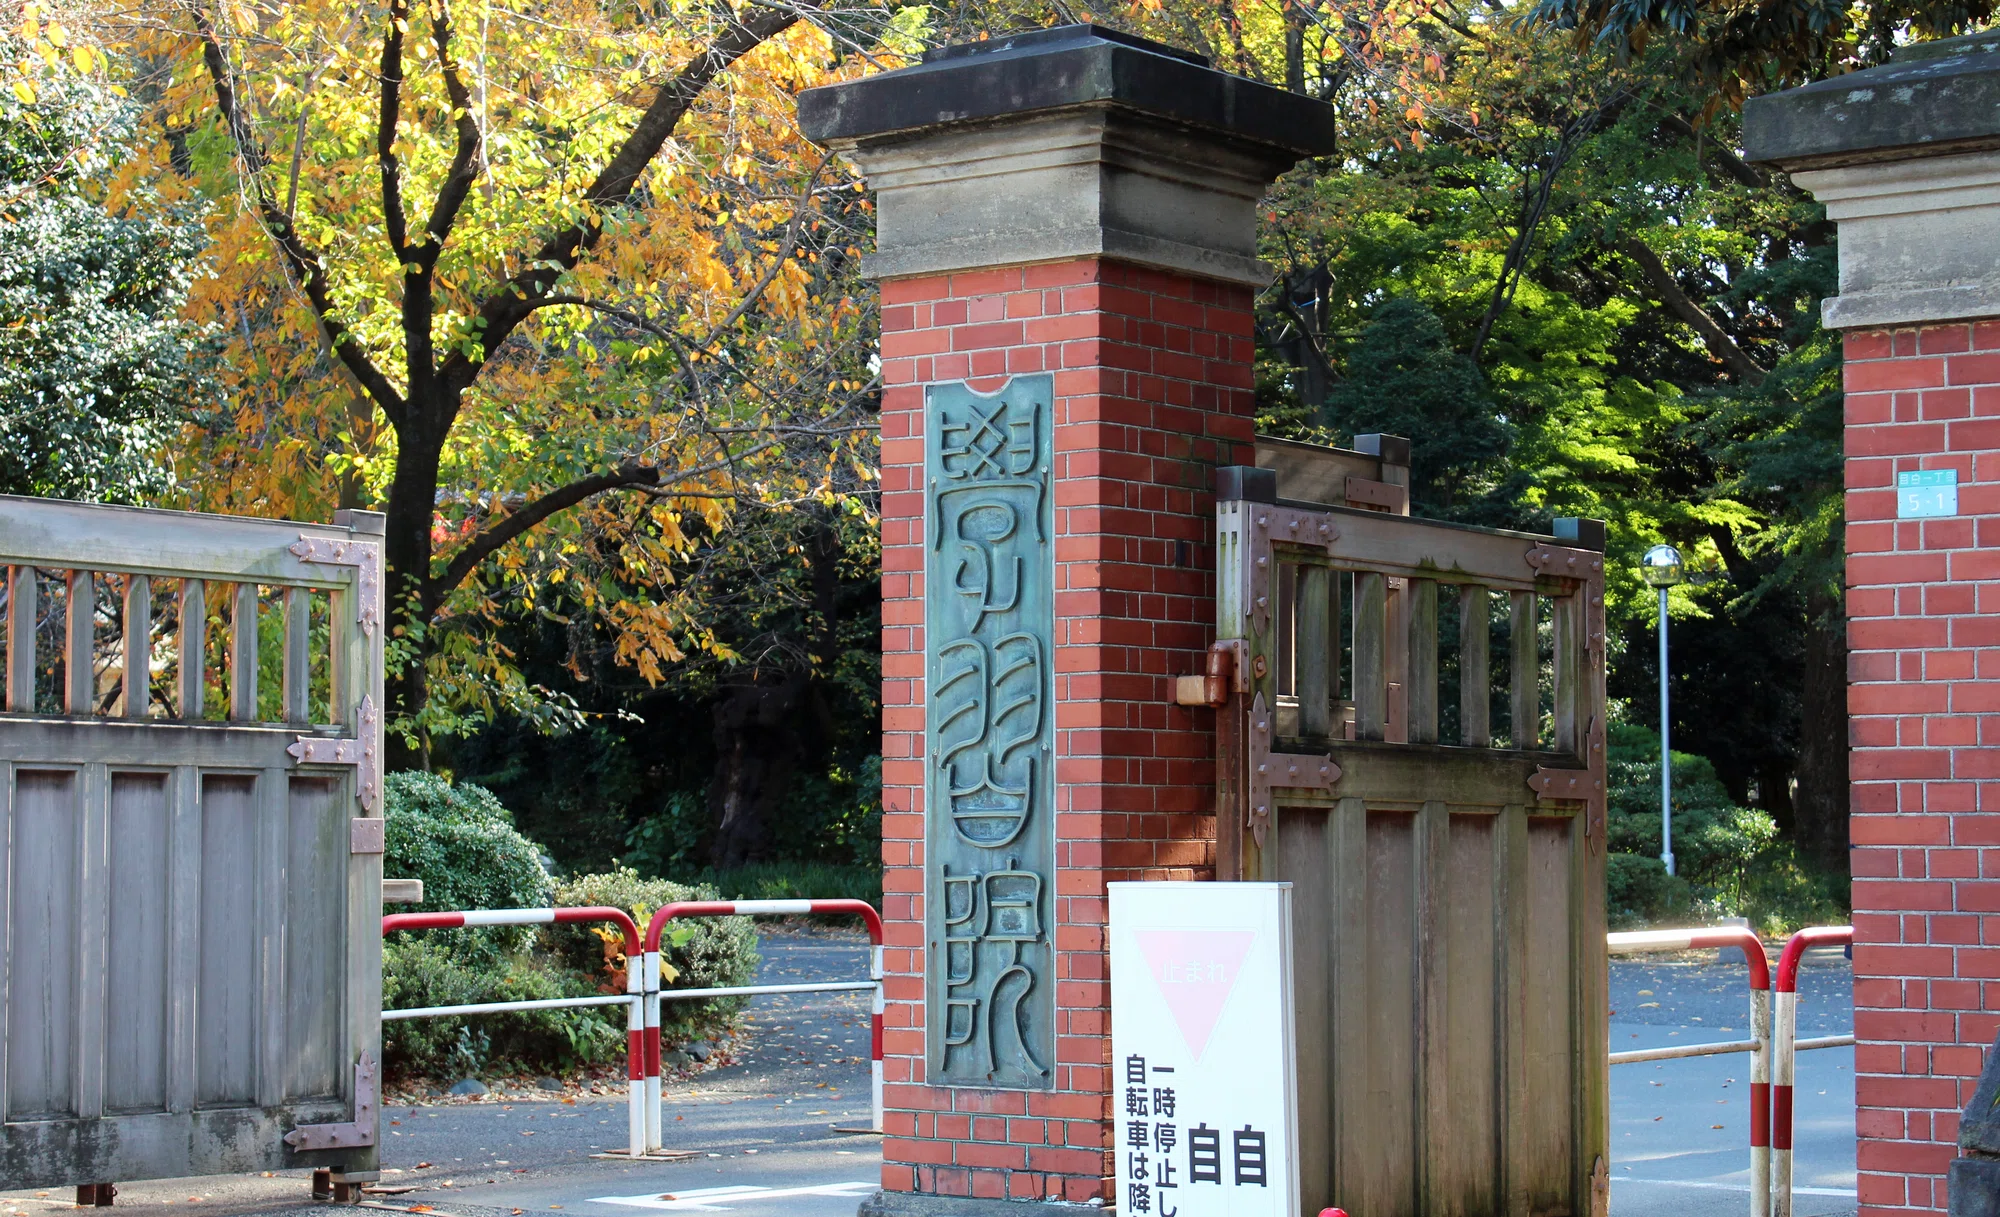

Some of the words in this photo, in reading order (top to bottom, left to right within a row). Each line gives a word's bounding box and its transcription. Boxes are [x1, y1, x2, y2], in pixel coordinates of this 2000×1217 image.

[1161, 959, 1227, 984] 止まれ
[1126, 1054, 1150, 1217] 自転車は降
[1152, 1067, 1178, 1217] 一時停止し
[1188, 1122, 1221, 1186] 自
[1233, 1124, 1267, 1187] 自
